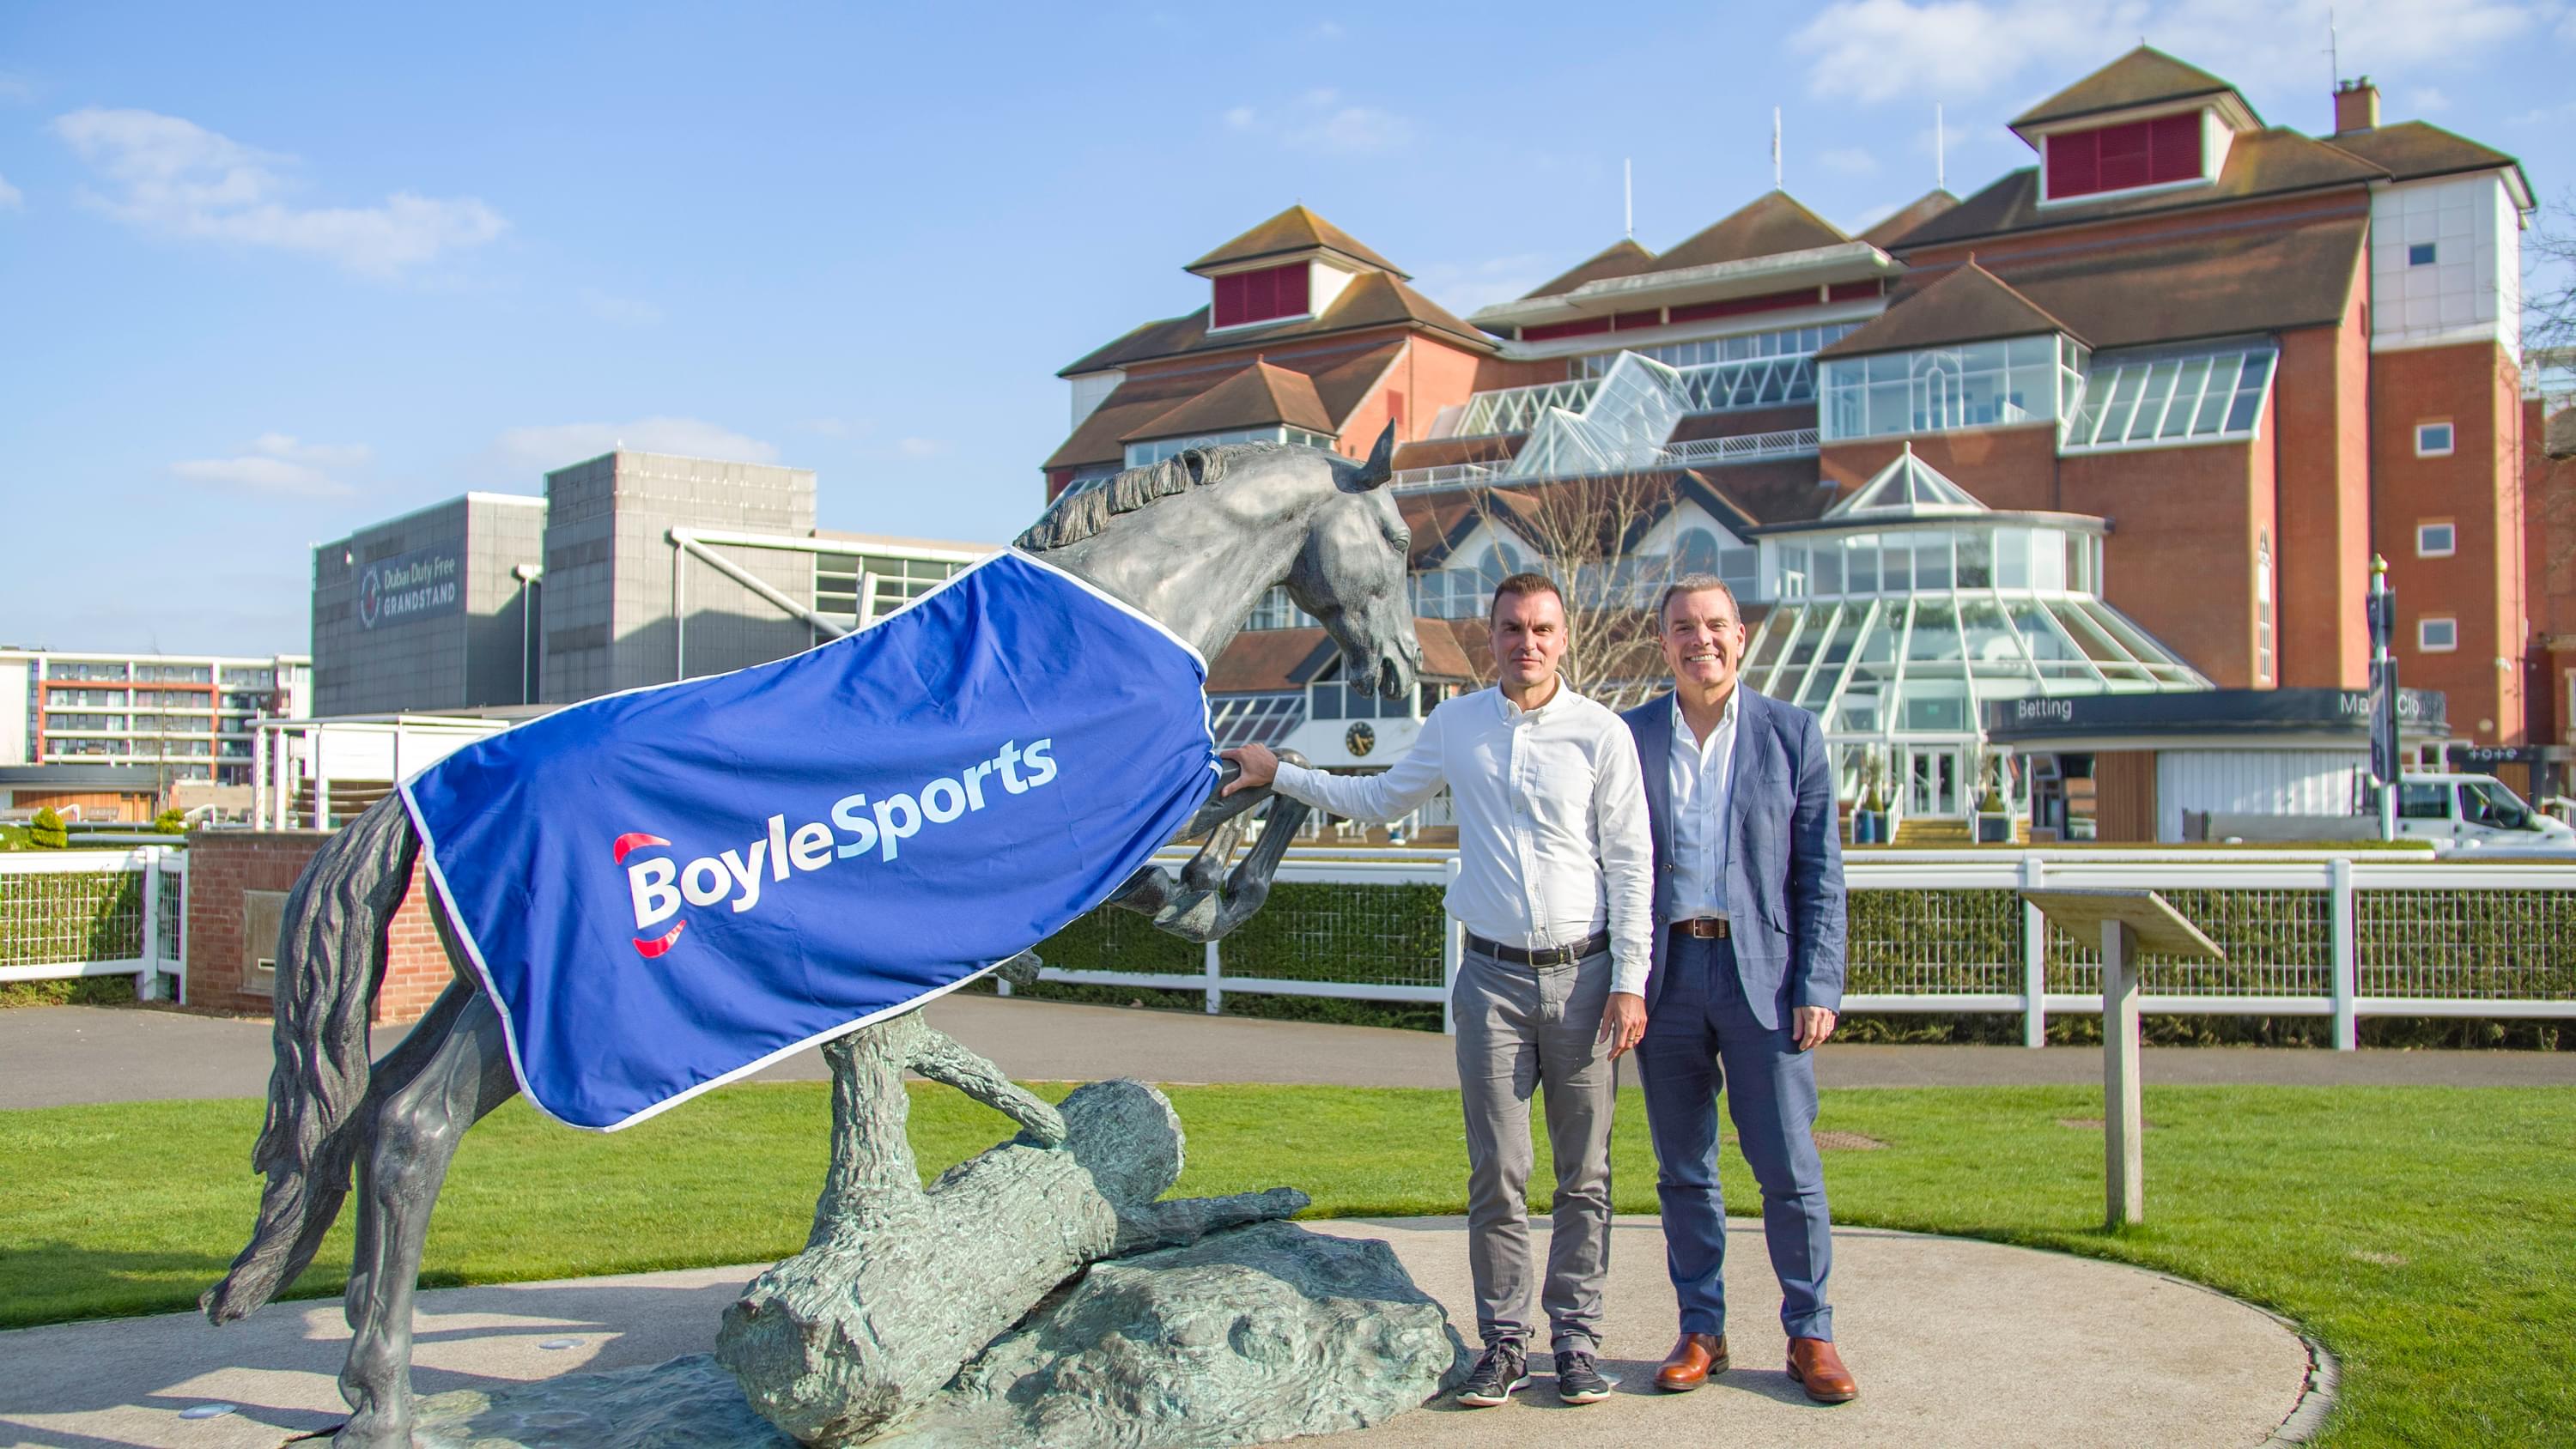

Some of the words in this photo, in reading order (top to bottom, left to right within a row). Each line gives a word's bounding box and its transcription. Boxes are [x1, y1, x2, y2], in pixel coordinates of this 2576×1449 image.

[384, 567, 410, 591] Dubai
[412, 560, 433, 585] Duty
[434, 556, 455, 578] Free
[384, 582, 455, 617] GRANDSTAND
[2018, 698, 2072, 721] Betting
[2340, 693, 2369, 715] Ma
[2469, 748, 2518, 761] tote
[627, 737, 1058, 930] BoyleSports
